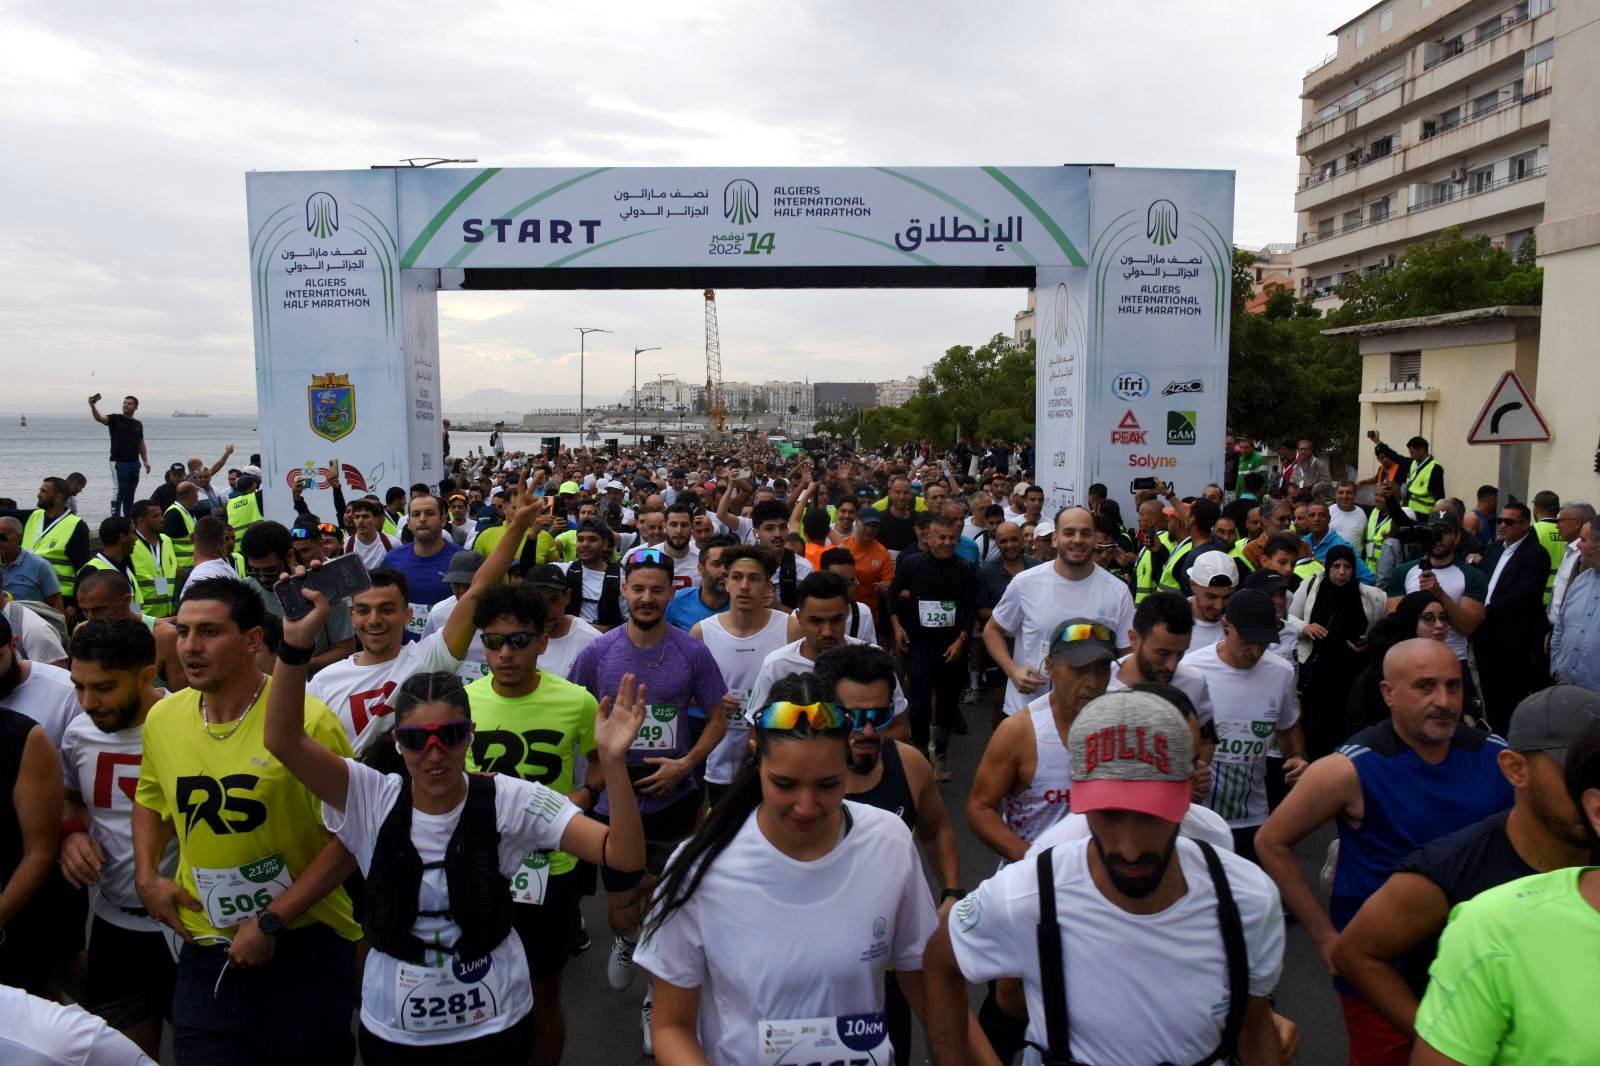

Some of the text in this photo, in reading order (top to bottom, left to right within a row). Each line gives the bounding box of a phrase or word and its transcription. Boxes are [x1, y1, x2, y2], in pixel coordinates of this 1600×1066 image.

[670, 188, 709, 199] نصف
[774, 186, 820, 195] ALGIERS
[774, 197, 865, 206] INTERNATIONAL
[619, 206, 709, 221] الجزائر الدولي
[774, 207, 871, 217] HALF MARATHON
[462, 218, 601, 244] START
[712, 232, 745, 243] نوفمبر
[895, 216, 1022, 252] الإنطلاق
[709, 244, 741, 255] 2025
[743, 232, 775, 255] 14
[331, 246, 367, 257] نصف
[1167, 255, 1203, 265] نصف
[285, 259, 364, 275] الجزائر الدولي
[1123, 267, 1199, 280] الجزائر الدولي
[305, 278, 347, 288] ALGIERS
[1140, 285, 1180, 294] ALGIERS
[285, 288, 367, 298] INTERNATIONAL
[283, 298, 370, 309] HALF MARATHON
[1121, 295, 1199, 305] INTERNATIONAL
[1118, 305, 1201, 316] HALF MARATHON
[1118, 377, 1143, 390] ifri
[1111, 430, 1148, 445] PEAK
[1168, 429, 1194, 440] GAM
[1128, 454, 1177, 469] Solyne
[927, 612, 947, 622] 124
[638, 725, 662, 741] 49
[1086, 724, 1170, 774] BULLS
[1218, 738, 1264, 755] 1070
[471, 725, 565, 785] RS
[176, 769, 267, 841] RS
[218, 887, 273, 916] 506
[409, 986, 487, 1019] 3281
[844, 1018, 884, 1037] 10KM
